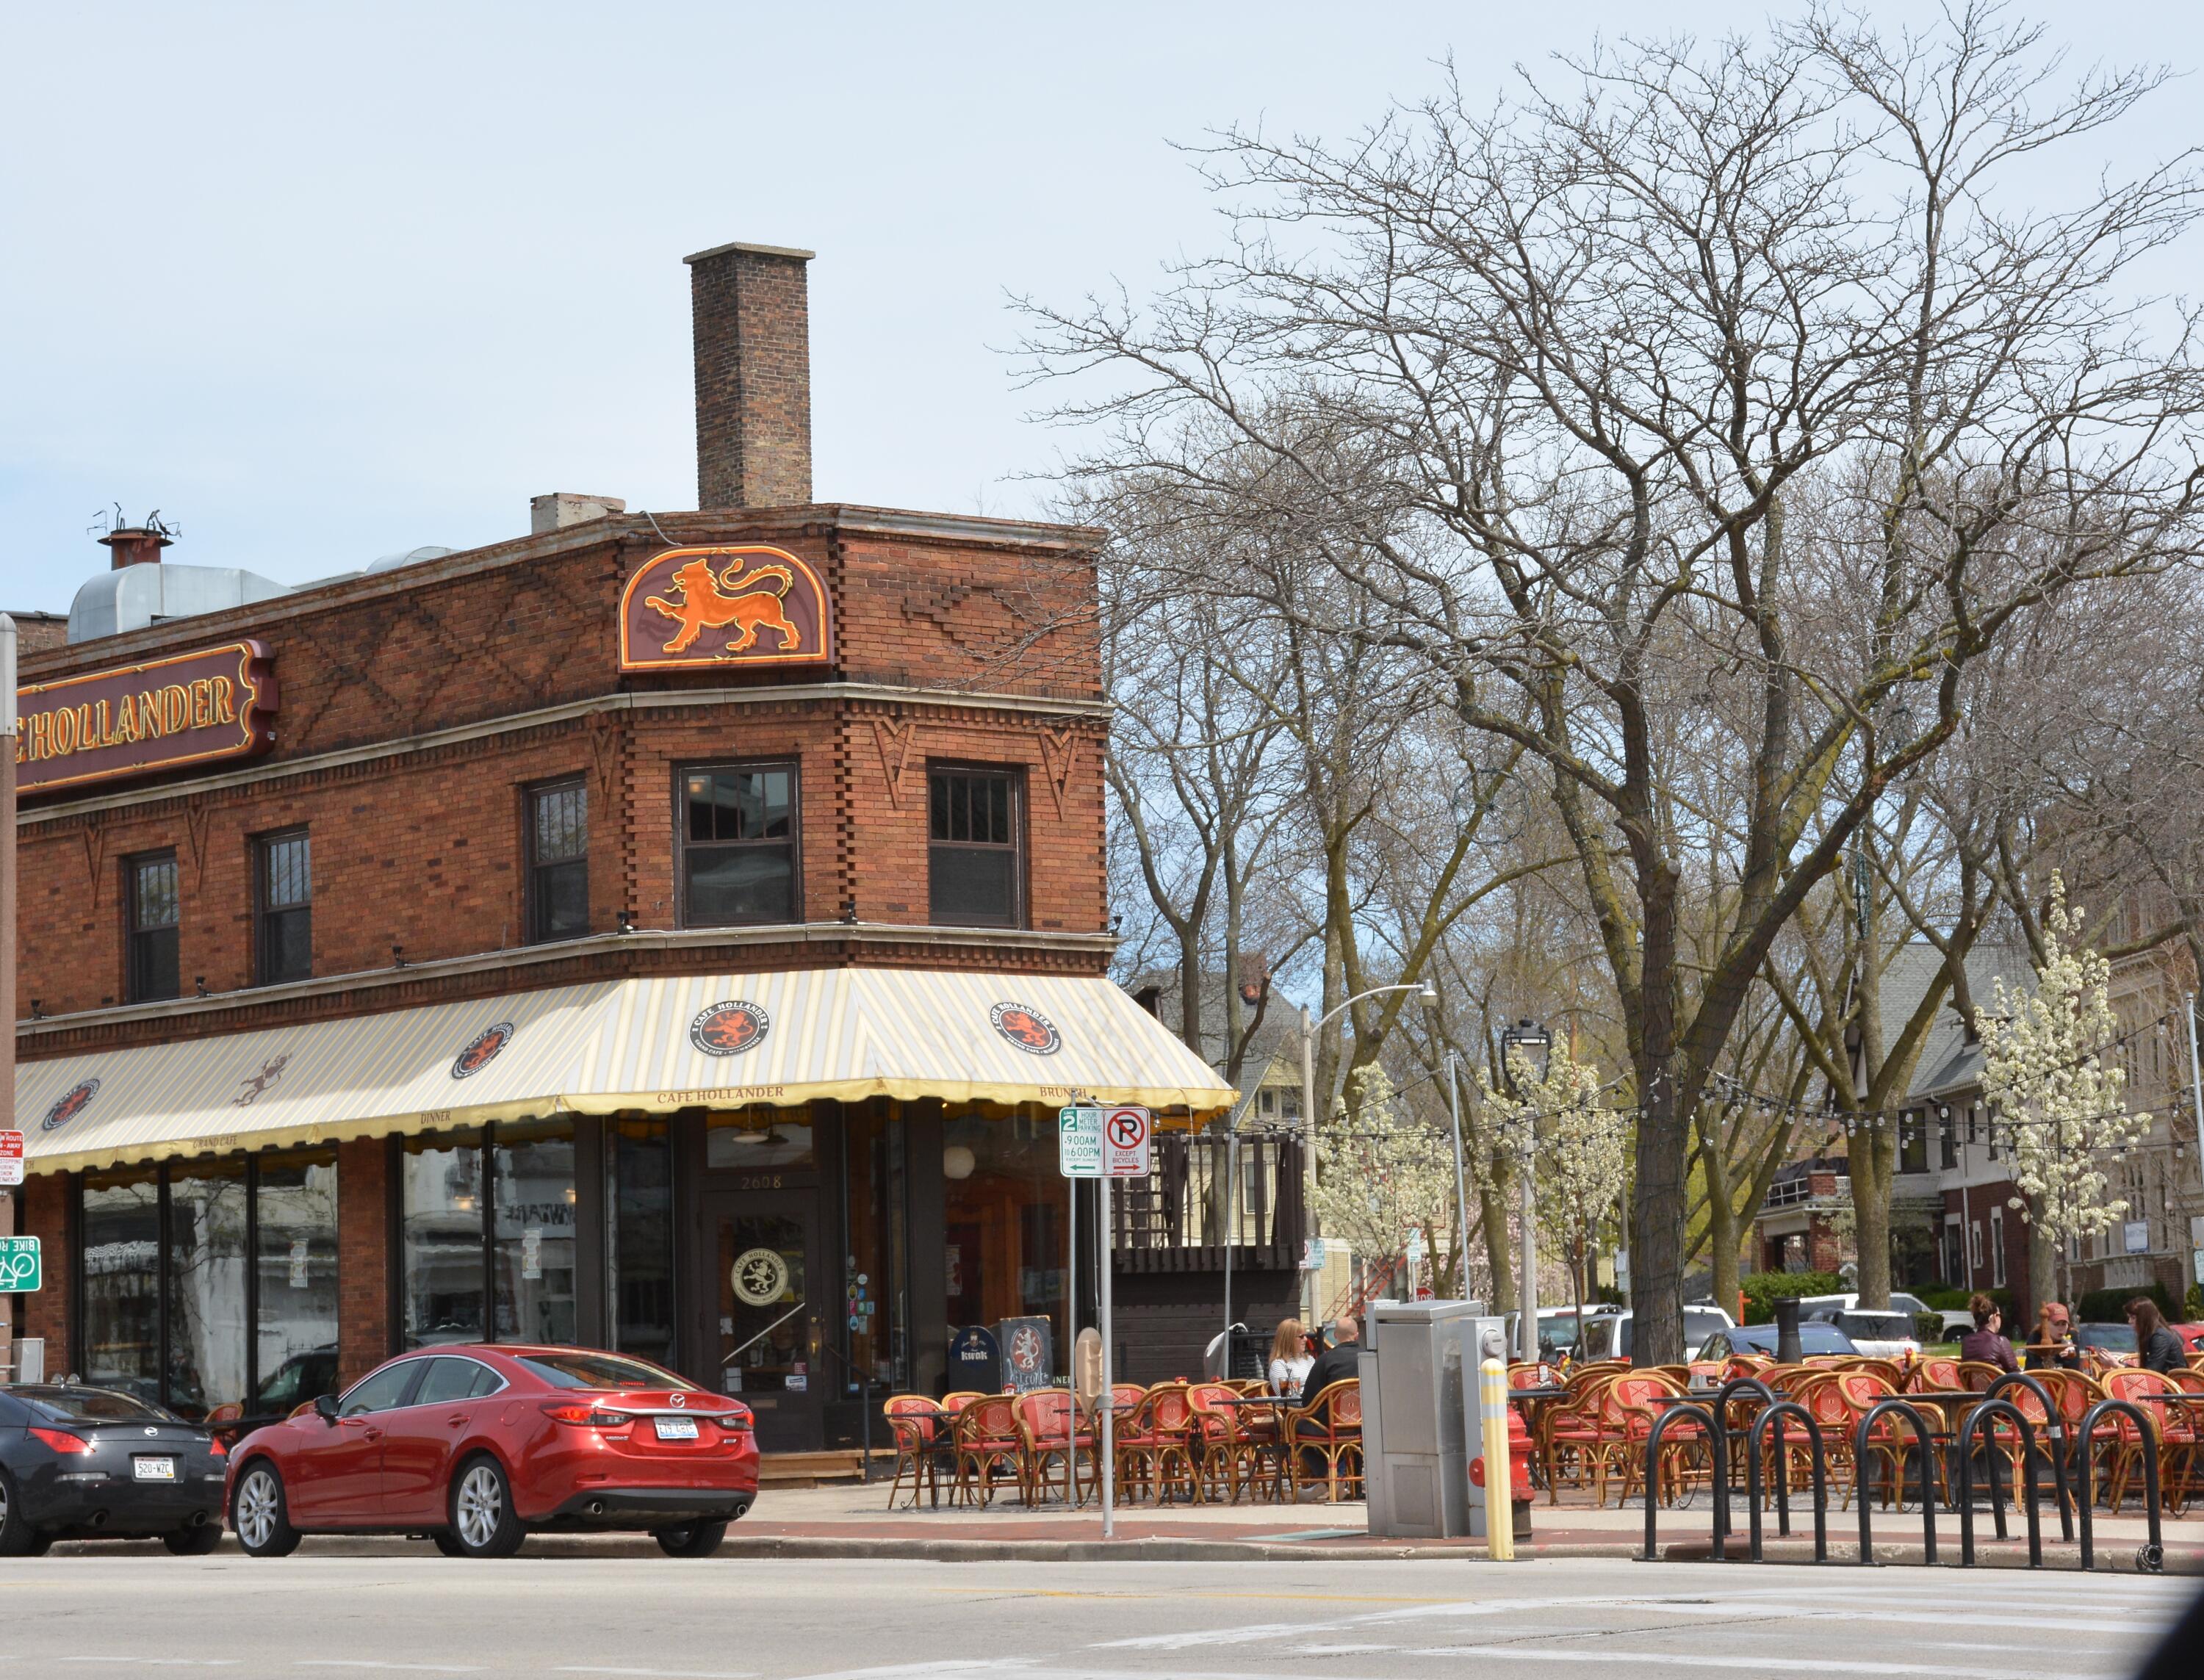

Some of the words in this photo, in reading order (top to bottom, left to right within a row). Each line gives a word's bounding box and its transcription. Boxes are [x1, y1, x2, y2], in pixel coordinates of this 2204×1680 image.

[29, 676, 237, 760] HOLLANDER
[694, 1008, 714, 1025] CAFE
[718, 1002, 768, 1025] HOLLANDER
[991, 1008, 1000, 1024] CAFE
[998, 1003, 1051, 1025] HOLLANDER
[1006, 1037, 1026, 1049] GRAND
[658, 1092, 693, 1104] CAFE
[697, 1086, 784, 1101] HOLLANDER
[1040, 1087, 1087, 1098] BRUNH
[421, 1110, 451, 1124] DINNER
[1063, 1115, 1076, 1131] 2
[193, 1137, 219, 1149] GRAND
[220, 1134, 238, 1147] CAFE
[741, 1175, 781, 1189] 2608
[12, 1240, 35, 1252] BIKE
[749, 1251, 784, 1271] HOLLANDER
